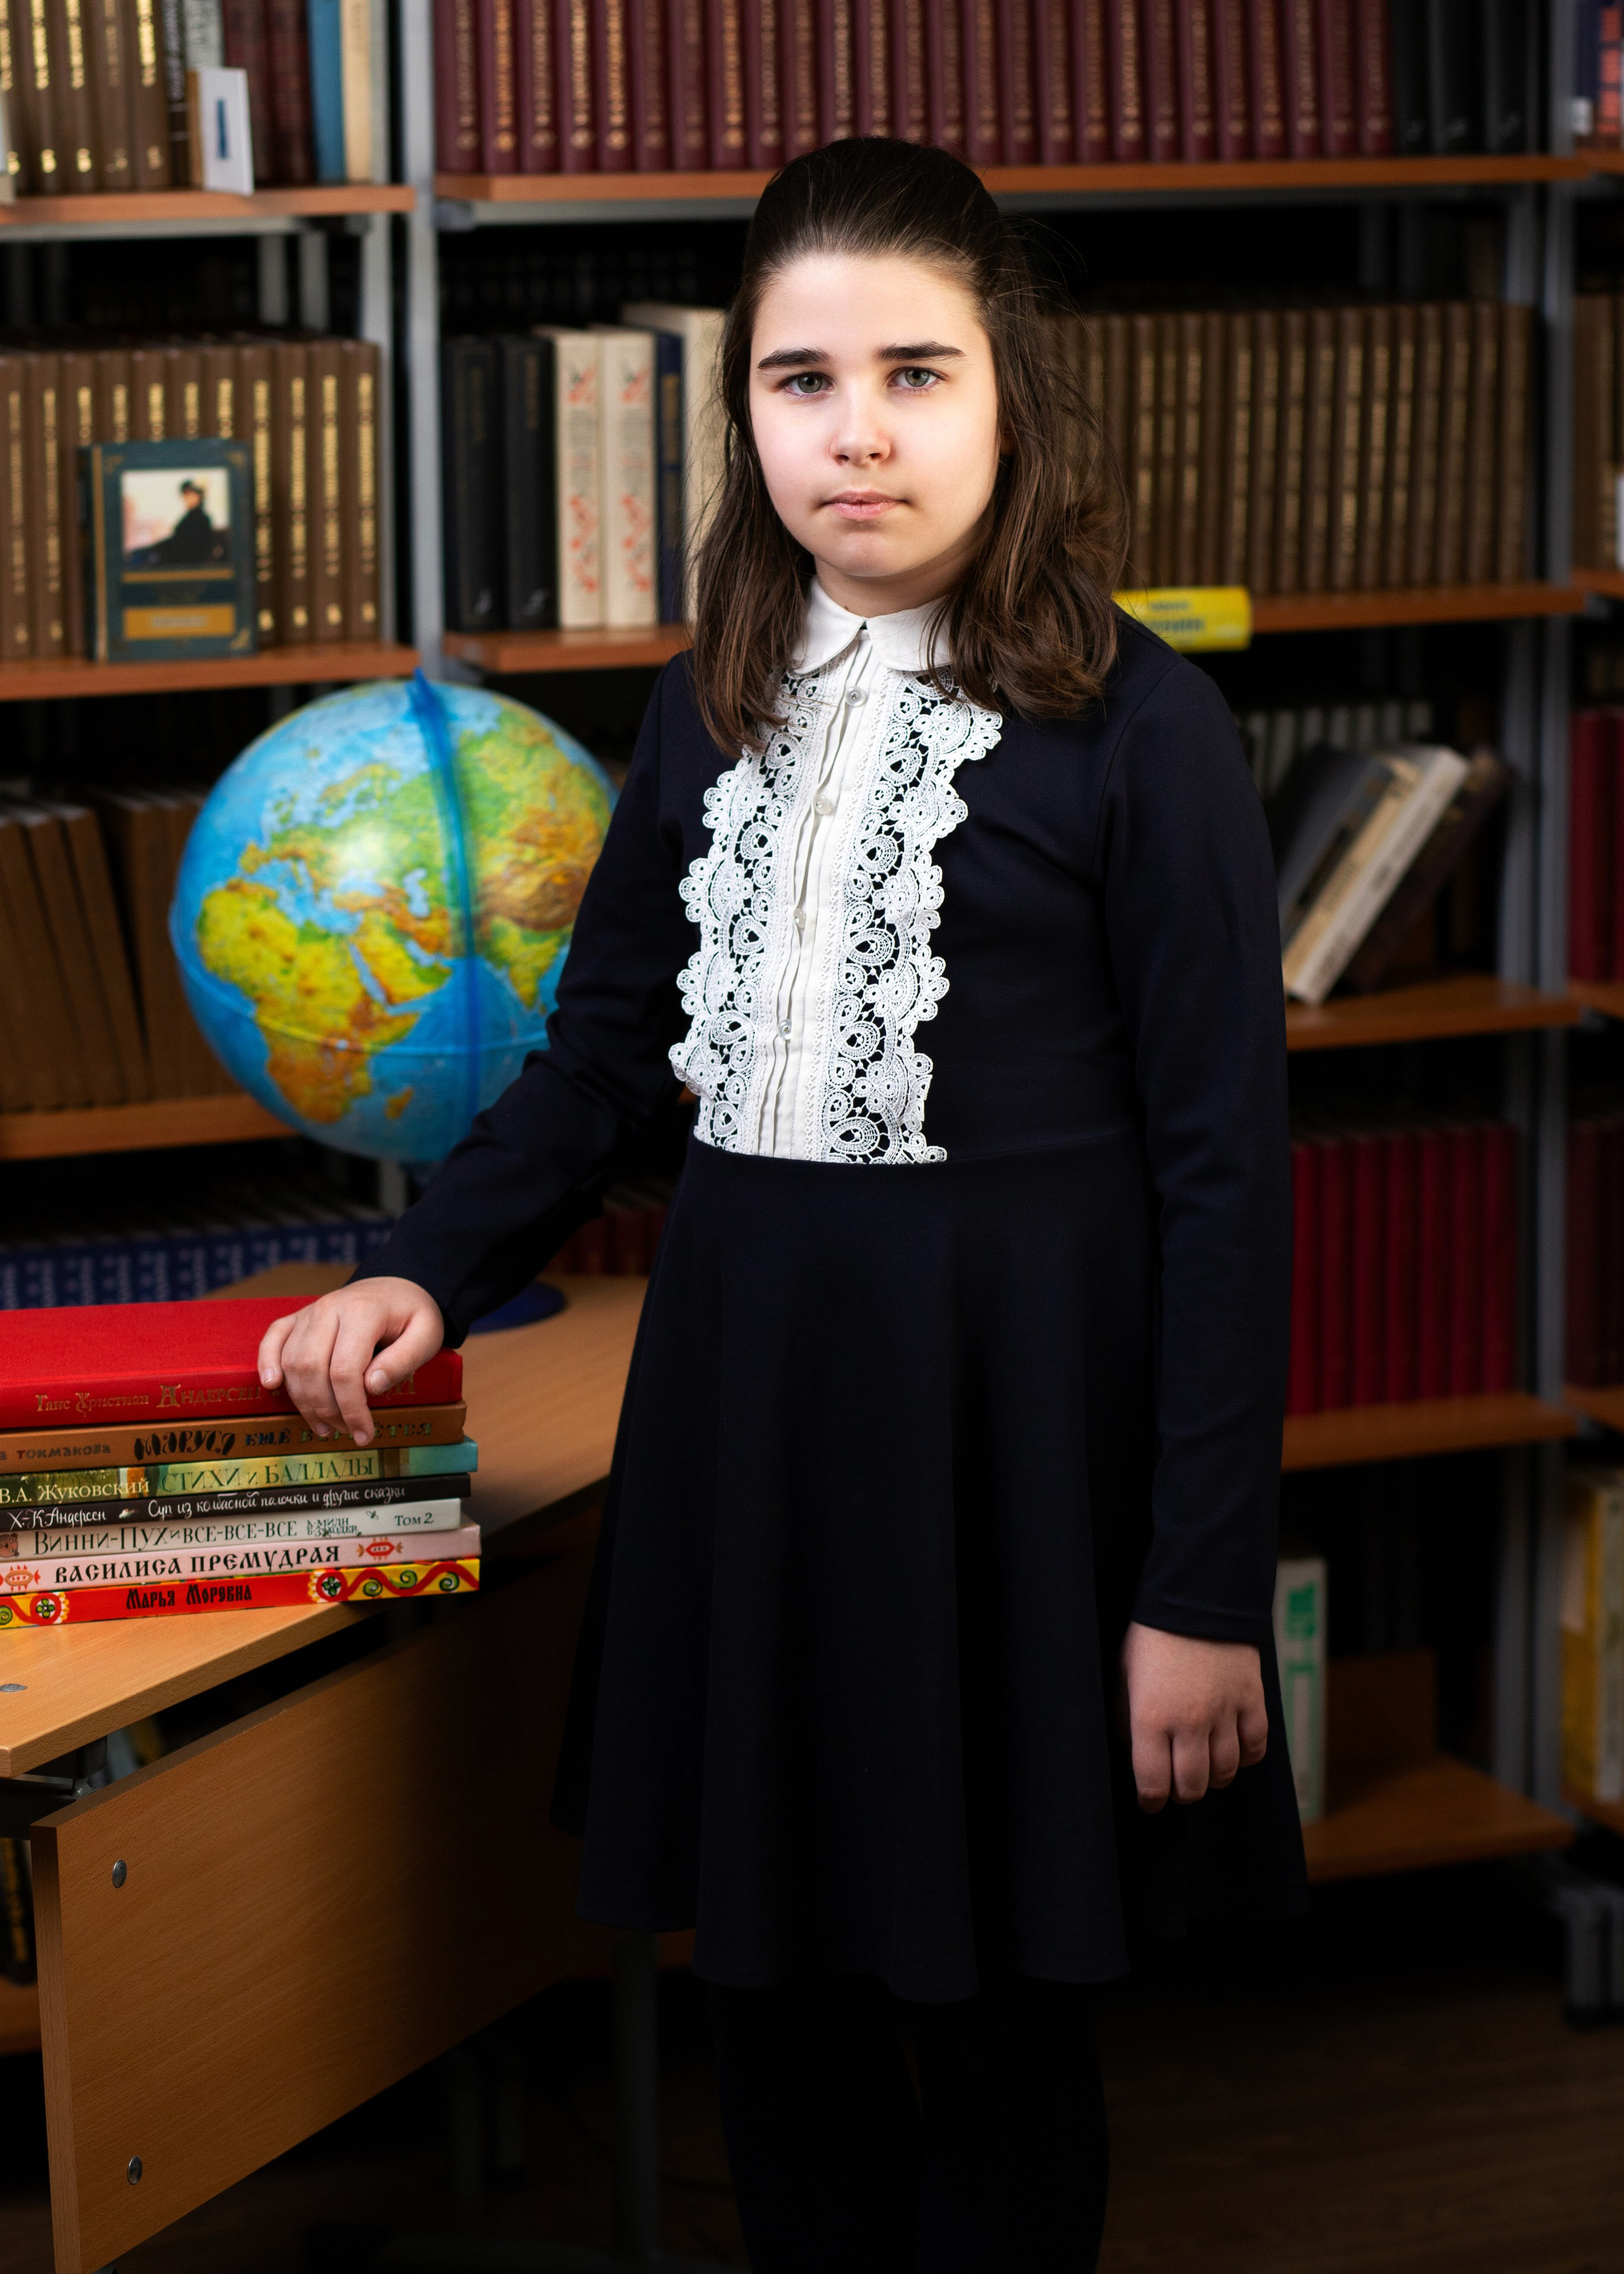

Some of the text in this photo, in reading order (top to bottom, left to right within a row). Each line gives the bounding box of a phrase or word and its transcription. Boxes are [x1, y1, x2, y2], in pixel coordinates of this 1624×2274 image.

[162, 1467, 240, 1492] СТИХИ
[264, 1457, 373, 1483] БАЛЛАДЫ
[148, 1500, 173, 1521] Суп
[177, 1502, 192, 1519] из
[261, 1493, 308, 1508] палочки
[364, 1486, 405, 1504] сказки
[424, 1512, 434, 1524] 2
[190, 1546, 339, 1572] ПРЕМУДРАЯ
